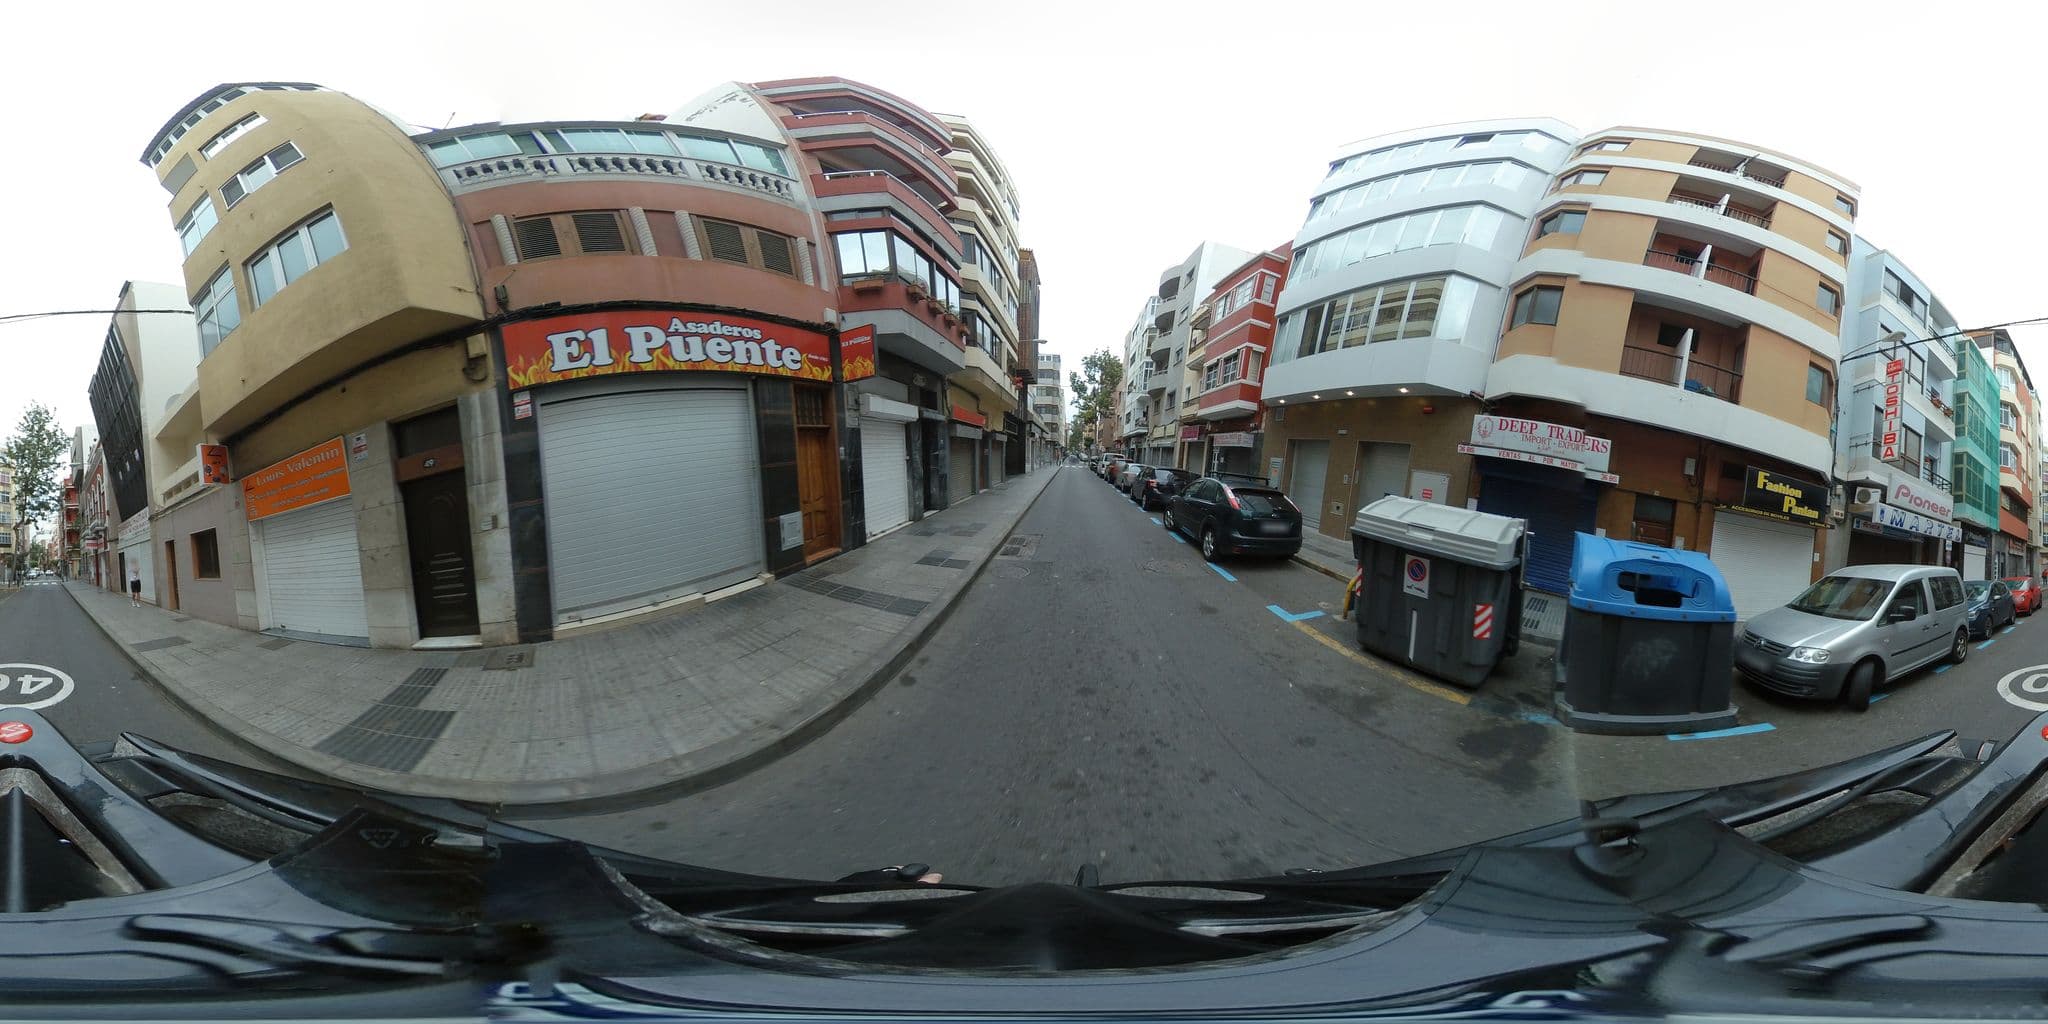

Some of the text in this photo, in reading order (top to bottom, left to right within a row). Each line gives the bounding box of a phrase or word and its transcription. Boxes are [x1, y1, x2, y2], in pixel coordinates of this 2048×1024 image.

[668, 317, 763, 340] Asaderos
[546, 326, 802, 372] El Puente
[1883, 373, 1900, 458] TOSHIBA
[1498, 418, 1538, 435] DEEP
[1547, 425, 1609, 454] TRADERS
[1521, 434, 1552, 445] IMPORT
[1498, 451, 1521, 460] VENTAS
[1542, 457, 1554, 465] POR
[1560, 460, 1578, 469] MAYOR
[1757, 470, 1802, 498] Fashion
[1894, 484, 1952, 517] Pioneer
